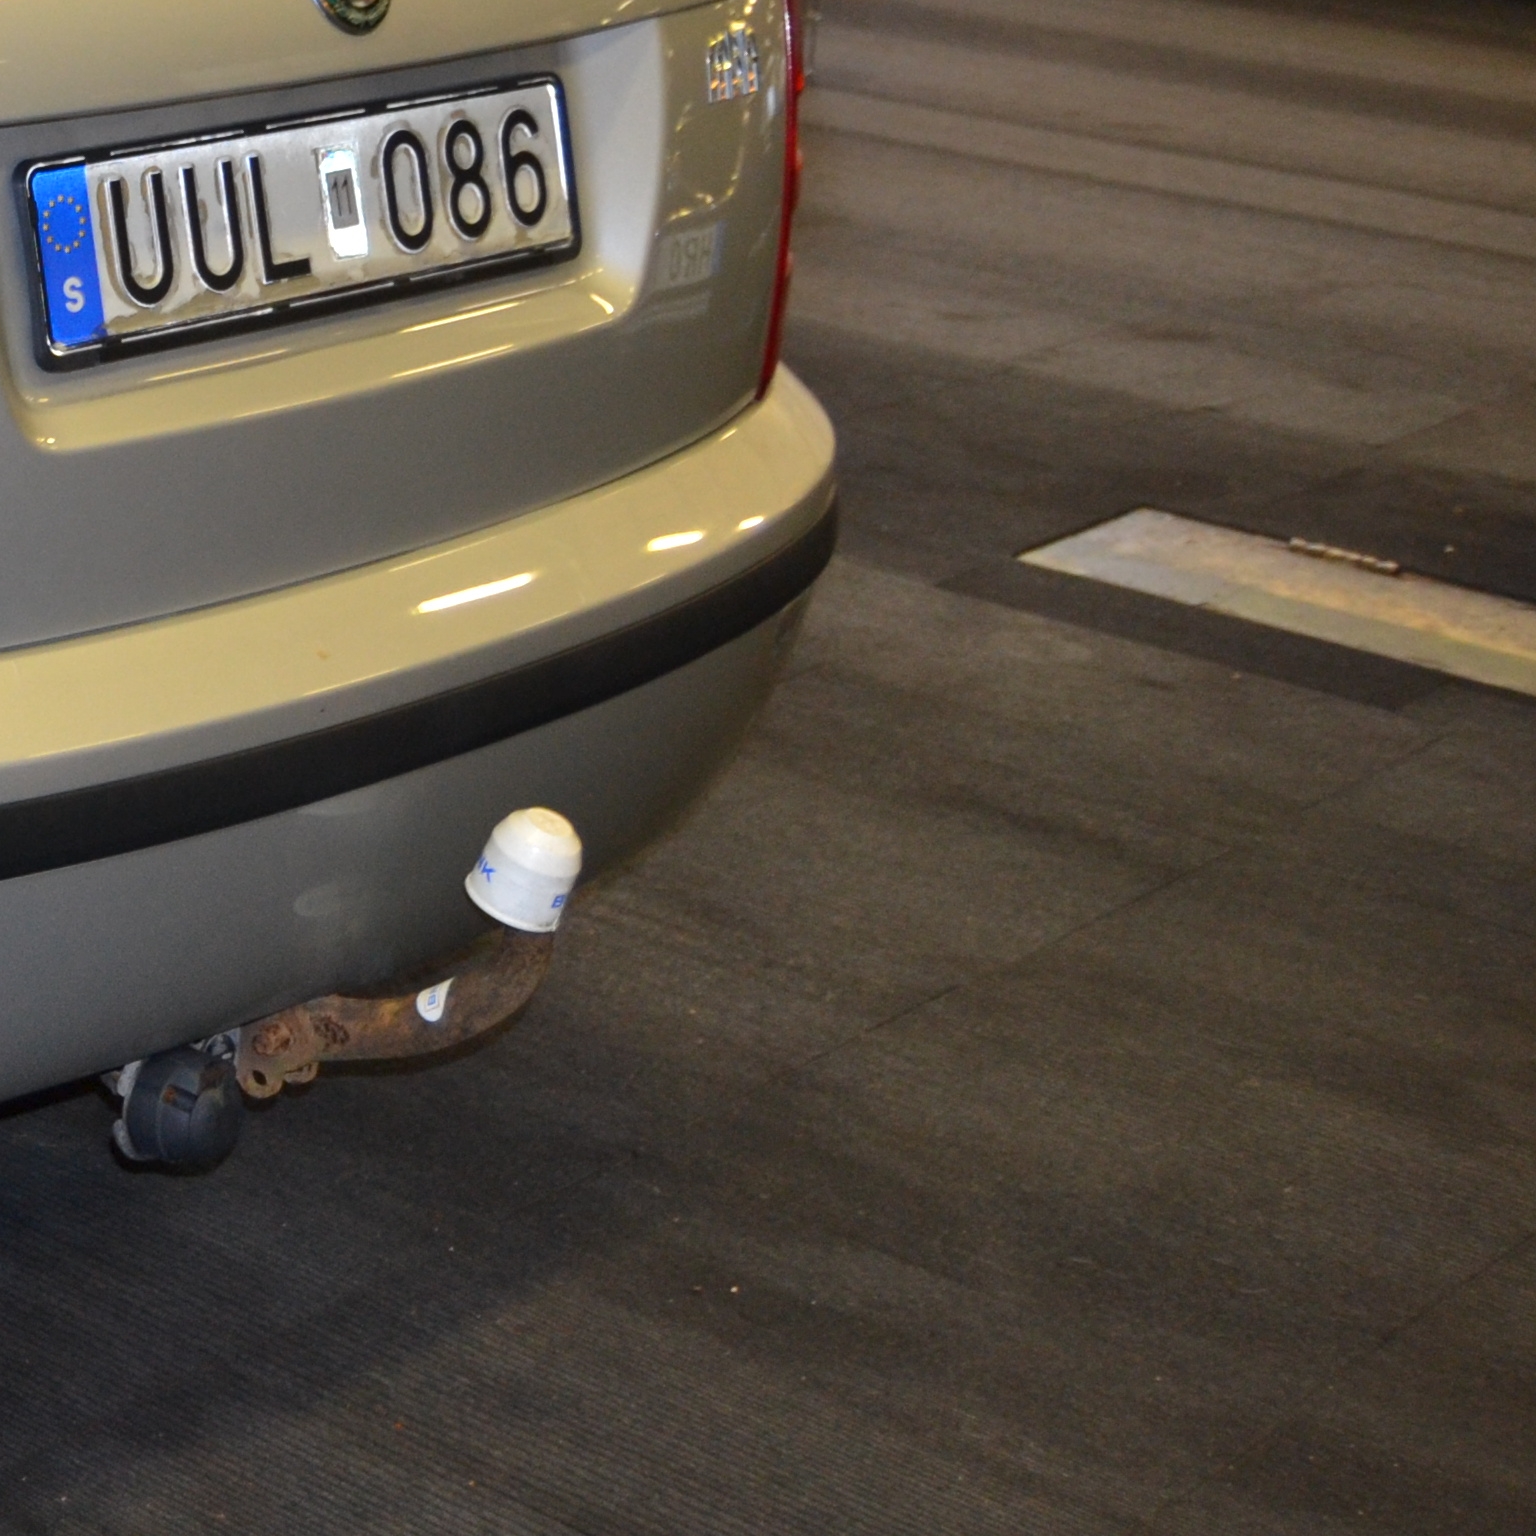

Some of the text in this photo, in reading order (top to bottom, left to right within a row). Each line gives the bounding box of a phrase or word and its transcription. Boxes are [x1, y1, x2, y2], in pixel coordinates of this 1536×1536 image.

[105, 107, 547, 308] UUL 086
[63, 276, 84, 313] S
